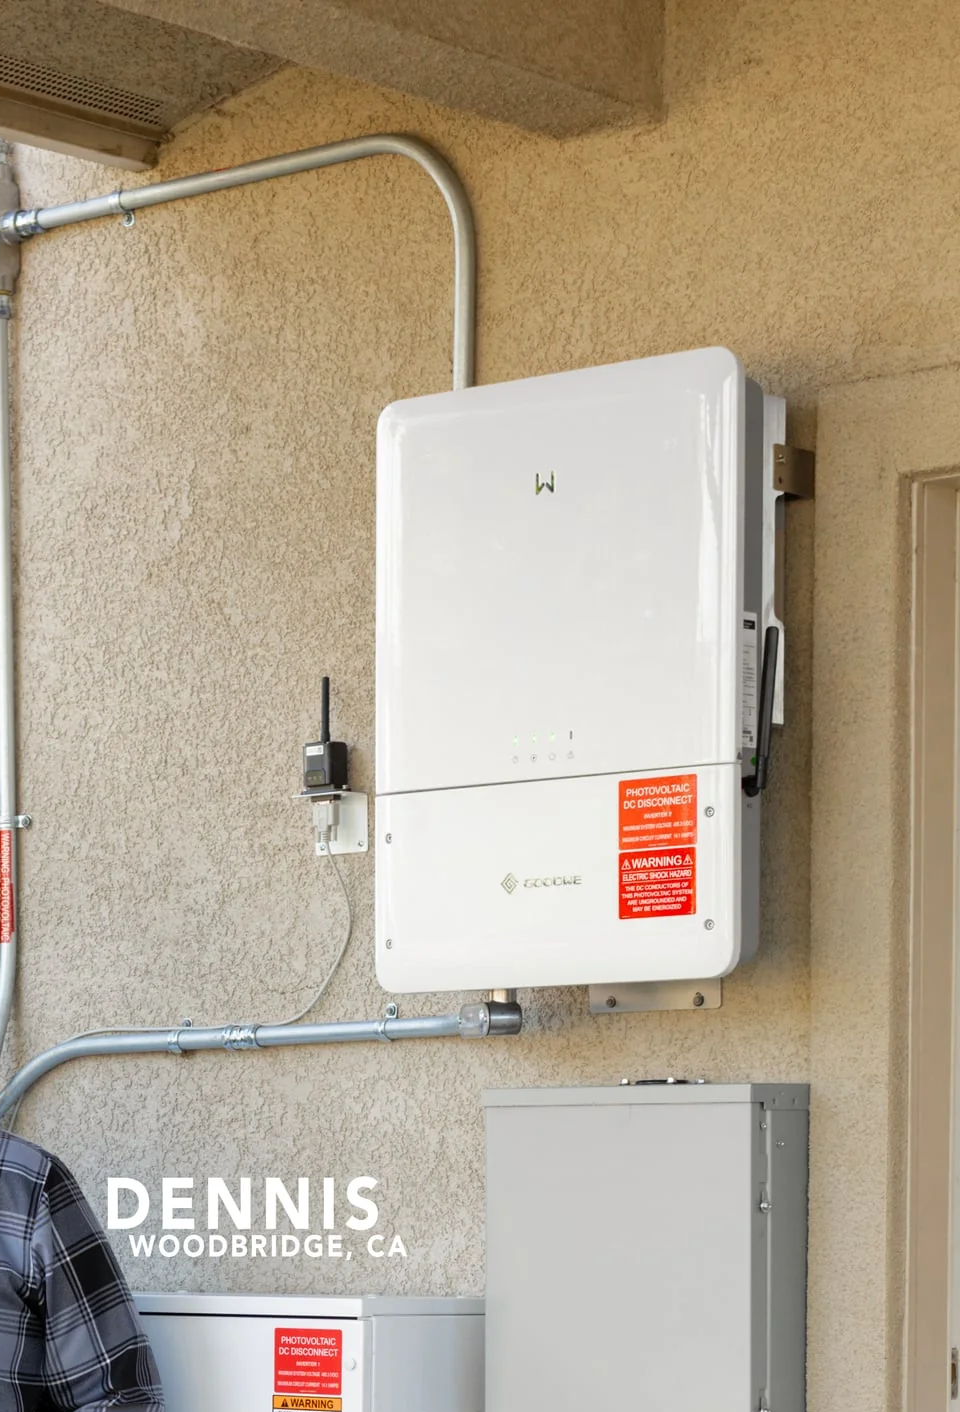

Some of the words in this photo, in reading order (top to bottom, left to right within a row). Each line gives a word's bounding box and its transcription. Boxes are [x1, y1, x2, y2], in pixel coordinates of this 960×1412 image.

[626, 783, 690, 797] PHOTOVOLTAIC
[624, 800, 636, 809] DC
[637, 795, 693, 808] DISCONNECT
[631, 855, 682, 868] WARNING
[622, 873, 648, 882] ELECTRIC
[649, 871, 668, 880] SHOCK
[669, 870, 692, 878] HAZARD
[644, 882, 680, 890] CONDUCTORS
[634, 890, 671, 898] PHOTOVOLTAIC
[639, 897, 675, 905] UNGROUNDED
[1, 878, 10, 942] PHOTOVOLTAIC
[281, 1336, 336, 1346] PHOTOVOLTAIC
[278, 1346, 290, 1356] DC
[290, 1347, 338, 1357] DISCONNECT
[290, 1398, 334, 1409] WARNING
